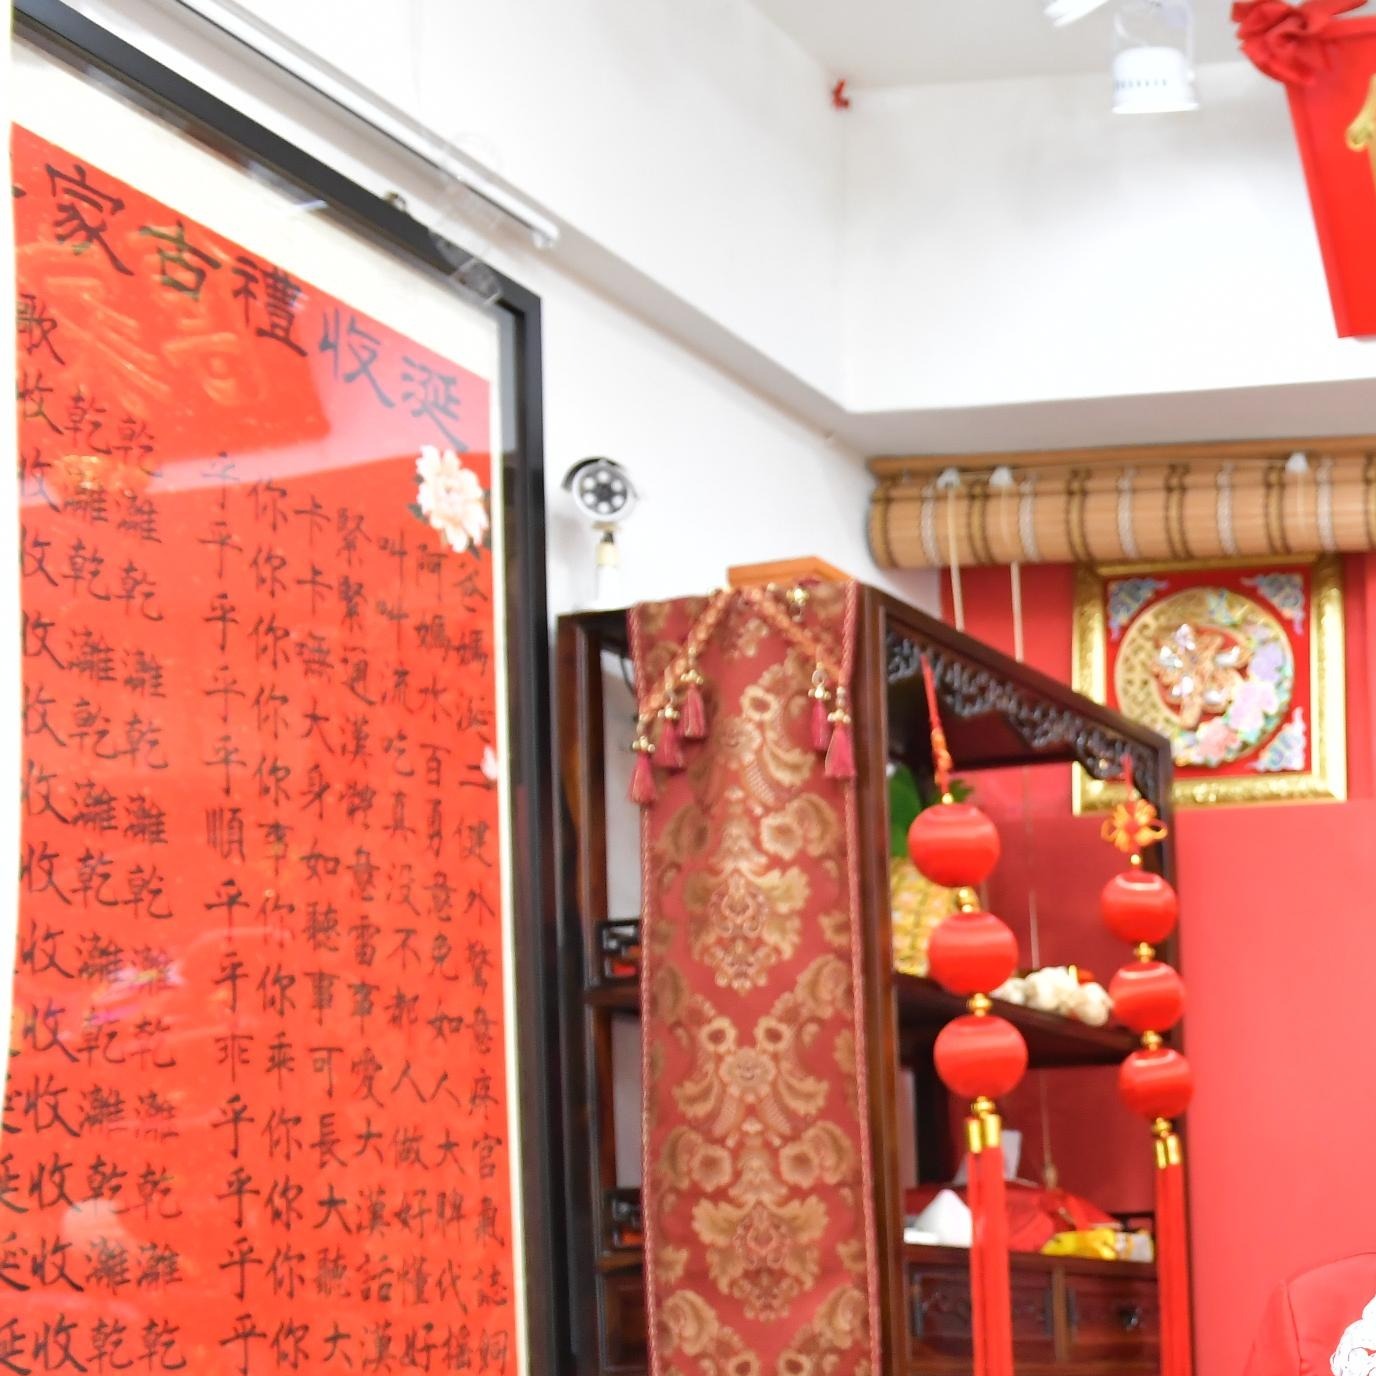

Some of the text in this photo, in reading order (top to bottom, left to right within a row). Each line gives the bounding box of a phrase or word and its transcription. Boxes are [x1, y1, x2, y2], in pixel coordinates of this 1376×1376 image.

[12, 161, 473, 454] 家古禮收涎
